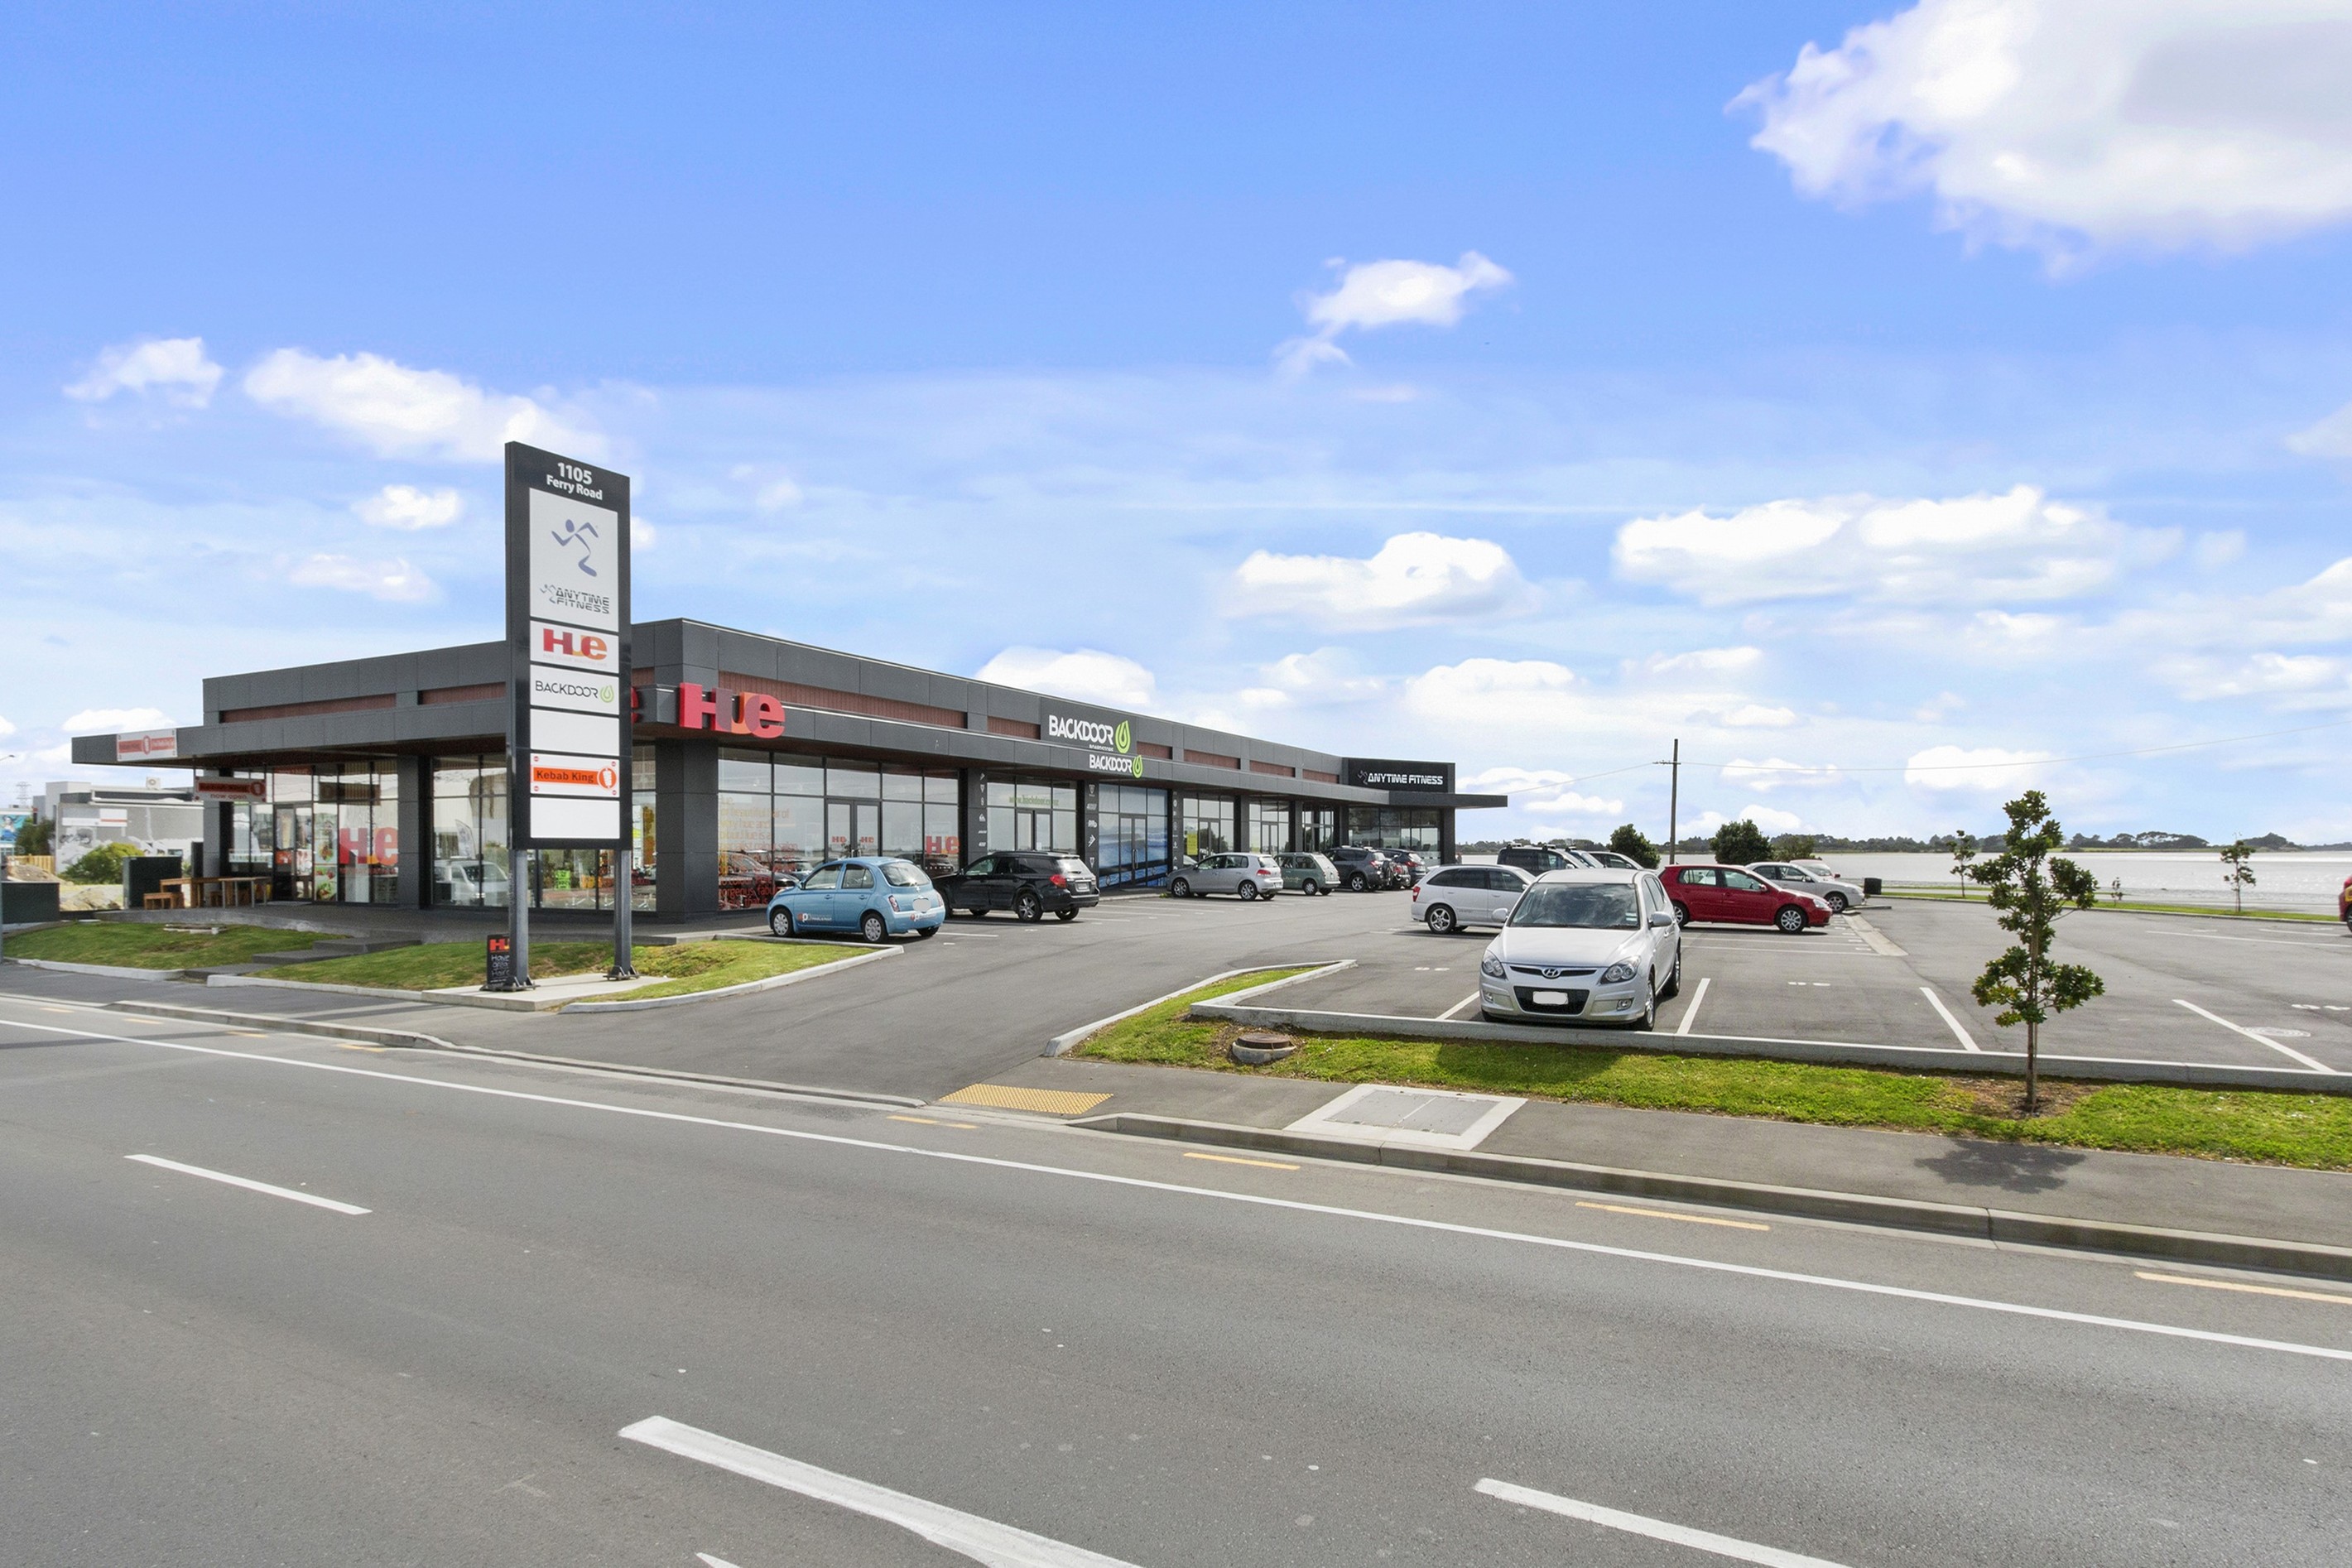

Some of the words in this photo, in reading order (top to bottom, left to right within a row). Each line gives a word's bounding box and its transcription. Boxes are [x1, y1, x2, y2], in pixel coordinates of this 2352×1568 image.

[557, 462, 592, 485] 1105
[546, 474, 575, 494] Ferry
[576, 483, 603, 500] Road
[556, 587, 609, 607] ANYTIME
[556, 597, 609, 614] FITNESS
[536, 681, 598, 698] BACKDOOR
[1049, 714, 1113, 745] BACKDOOR
[1089, 754, 1133, 773] BACKDOOR
[536, 770, 569, 781] Kebab
[572, 772, 594, 784] King
[1368, 772, 1407, 784] ANYTIME
[1408, 774, 1444, 786] FITNESS
